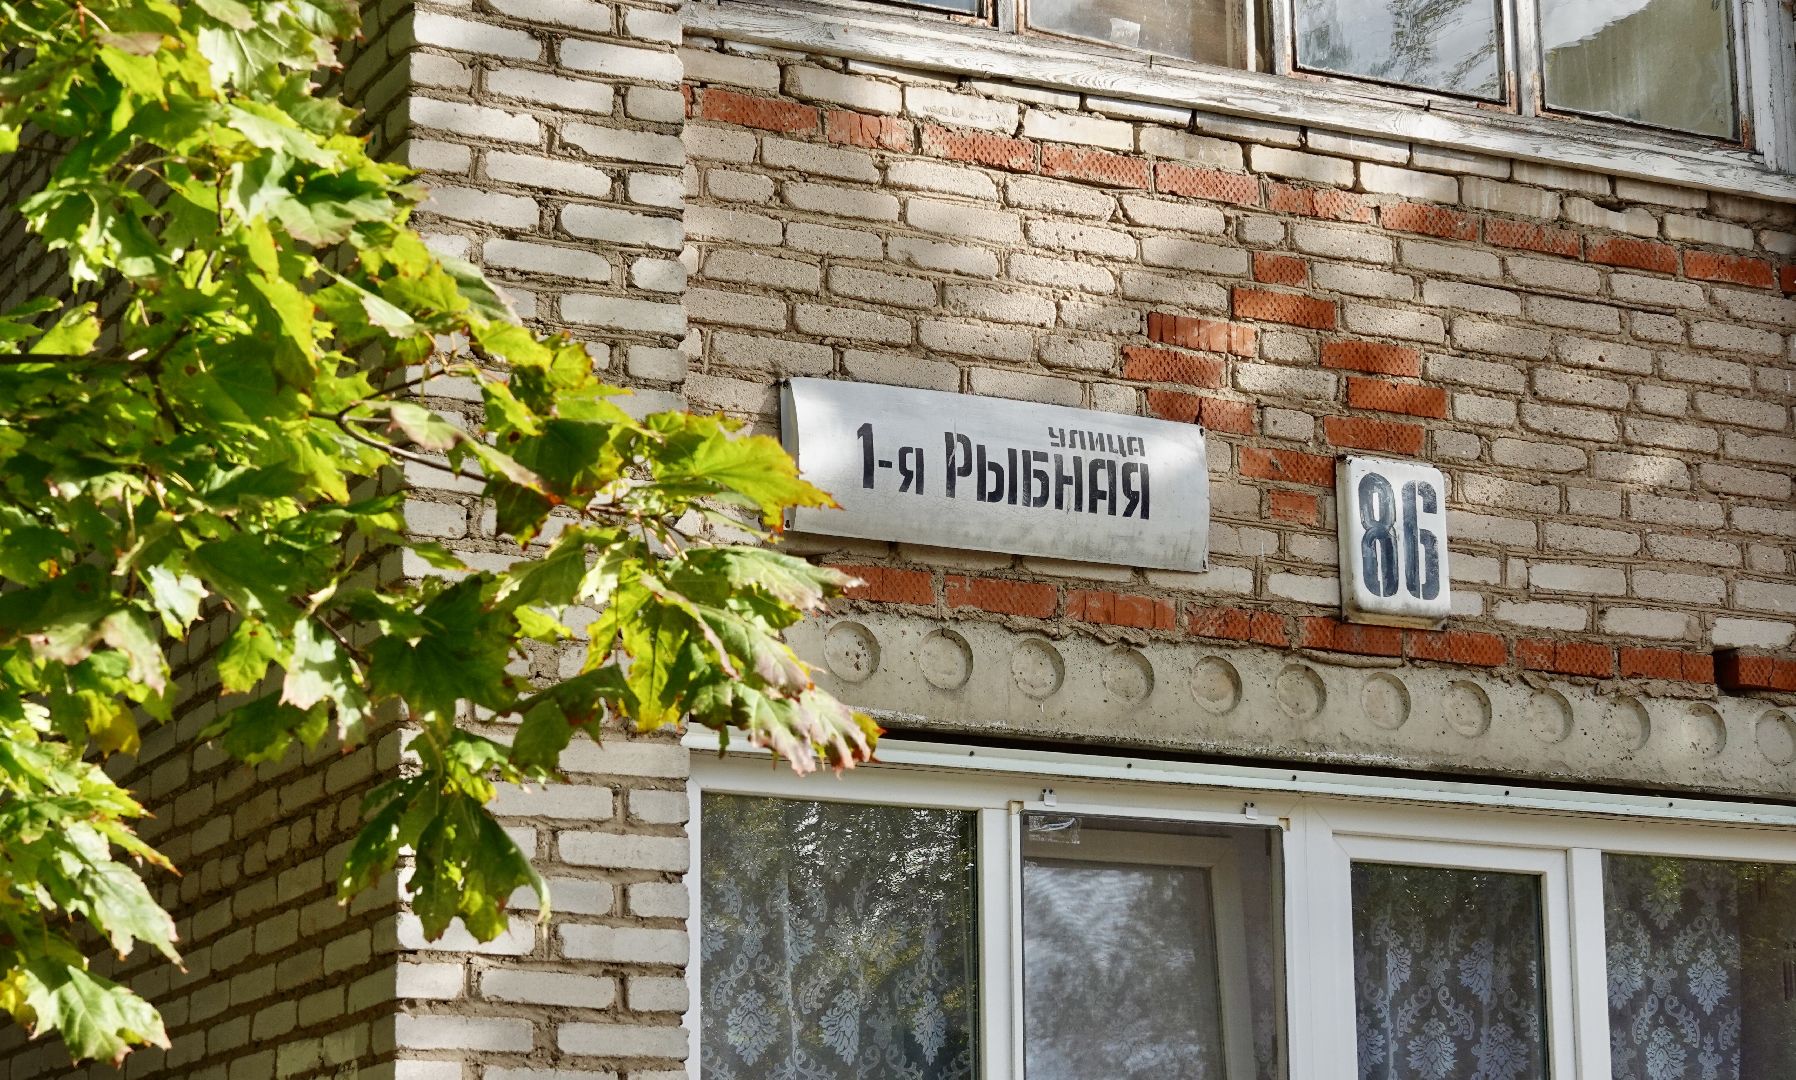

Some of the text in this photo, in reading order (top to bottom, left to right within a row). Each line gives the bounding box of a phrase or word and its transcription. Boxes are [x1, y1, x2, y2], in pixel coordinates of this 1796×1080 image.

[944, 431, 1150, 520] РЫБНАЯ
[1048, 426, 1145, 458] УЛИЦА
[1358, 472, 1440, 601] 86
